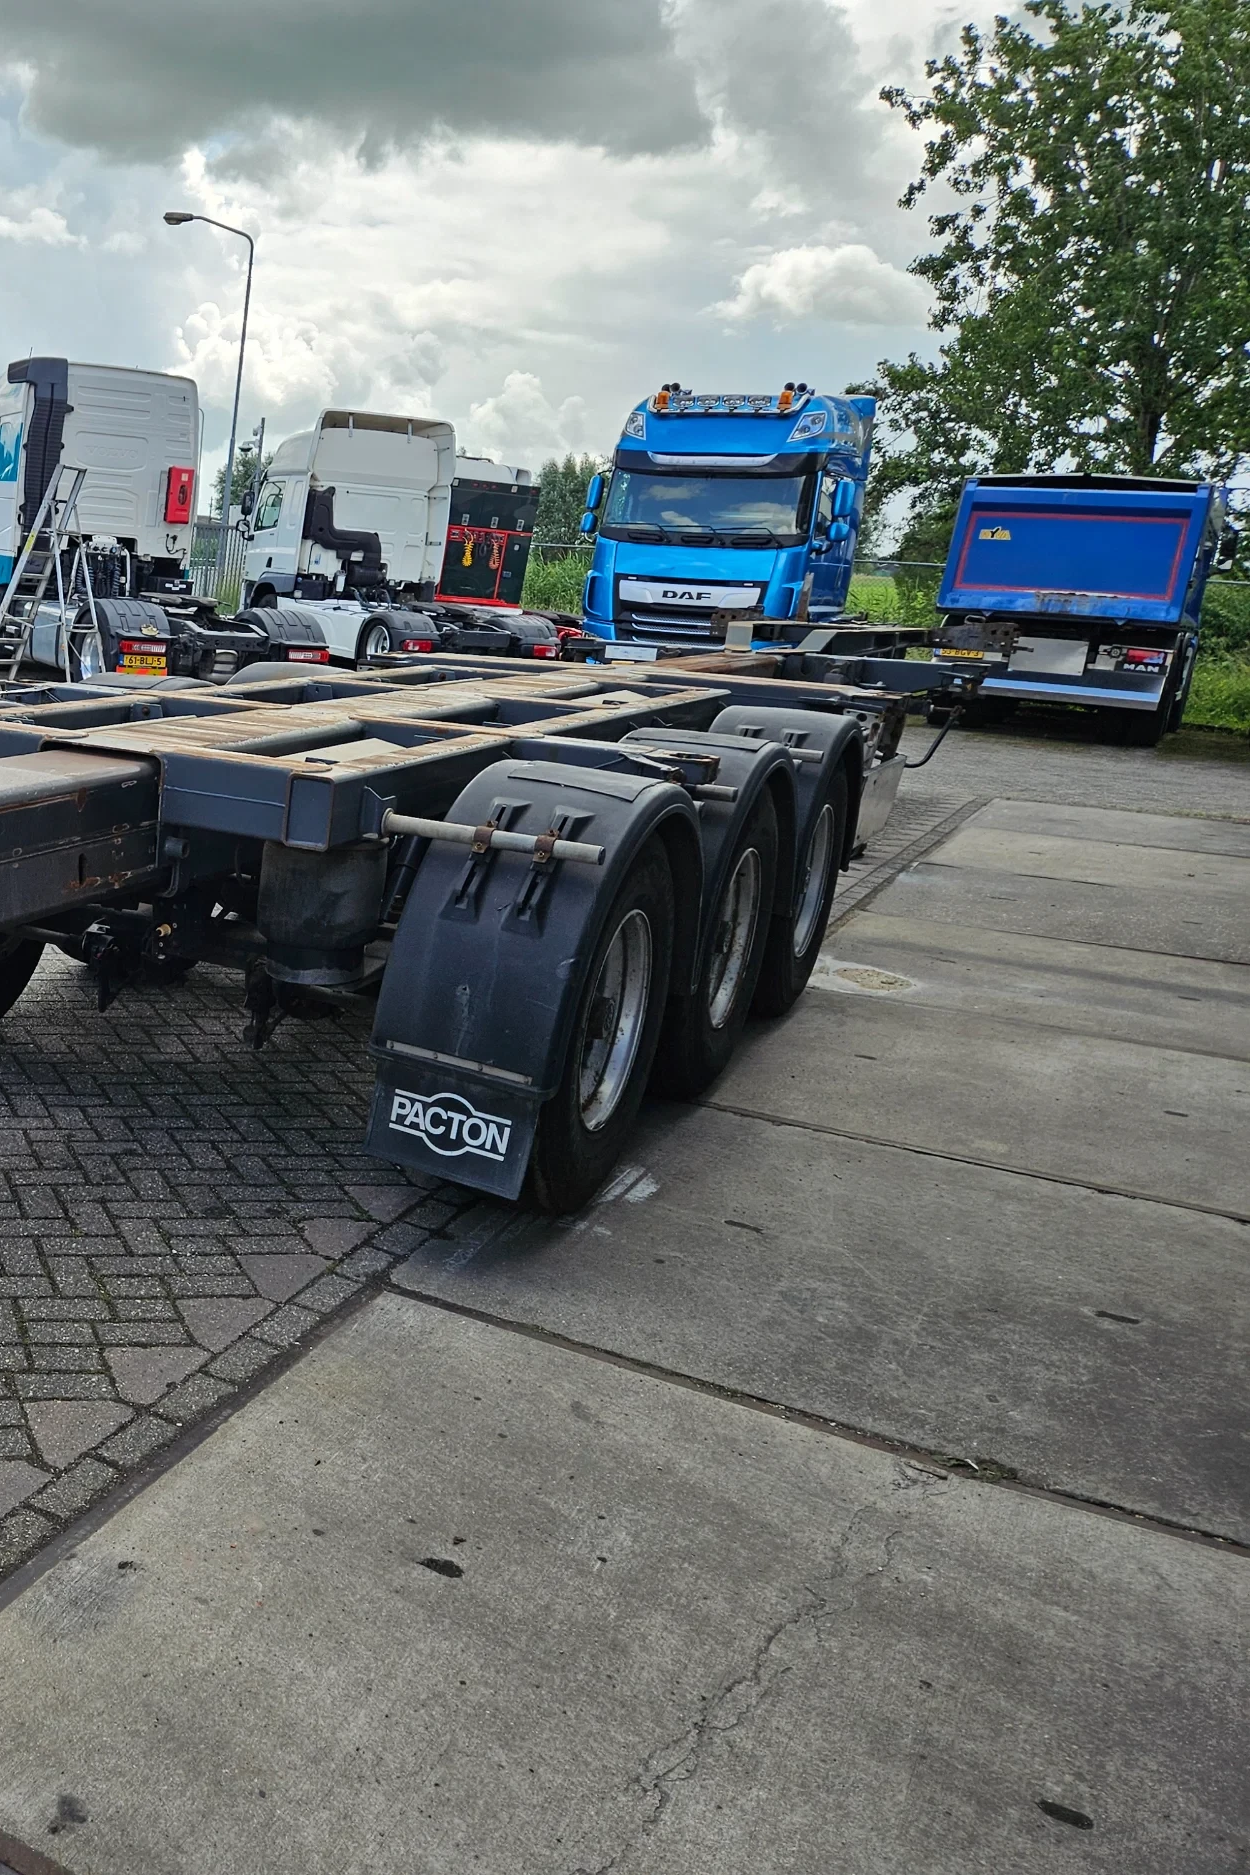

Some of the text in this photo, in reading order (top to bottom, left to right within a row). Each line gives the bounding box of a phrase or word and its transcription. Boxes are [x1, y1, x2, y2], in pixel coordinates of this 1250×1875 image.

[84, 445, 138, 459] VOLVO
[662, 590, 711, 600] DAF
[128, 656, 162, 666] 61-BLJ-5
[1123, 663, 1159, 673] MAN
[390, 1095, 511, 1155] PACTON
